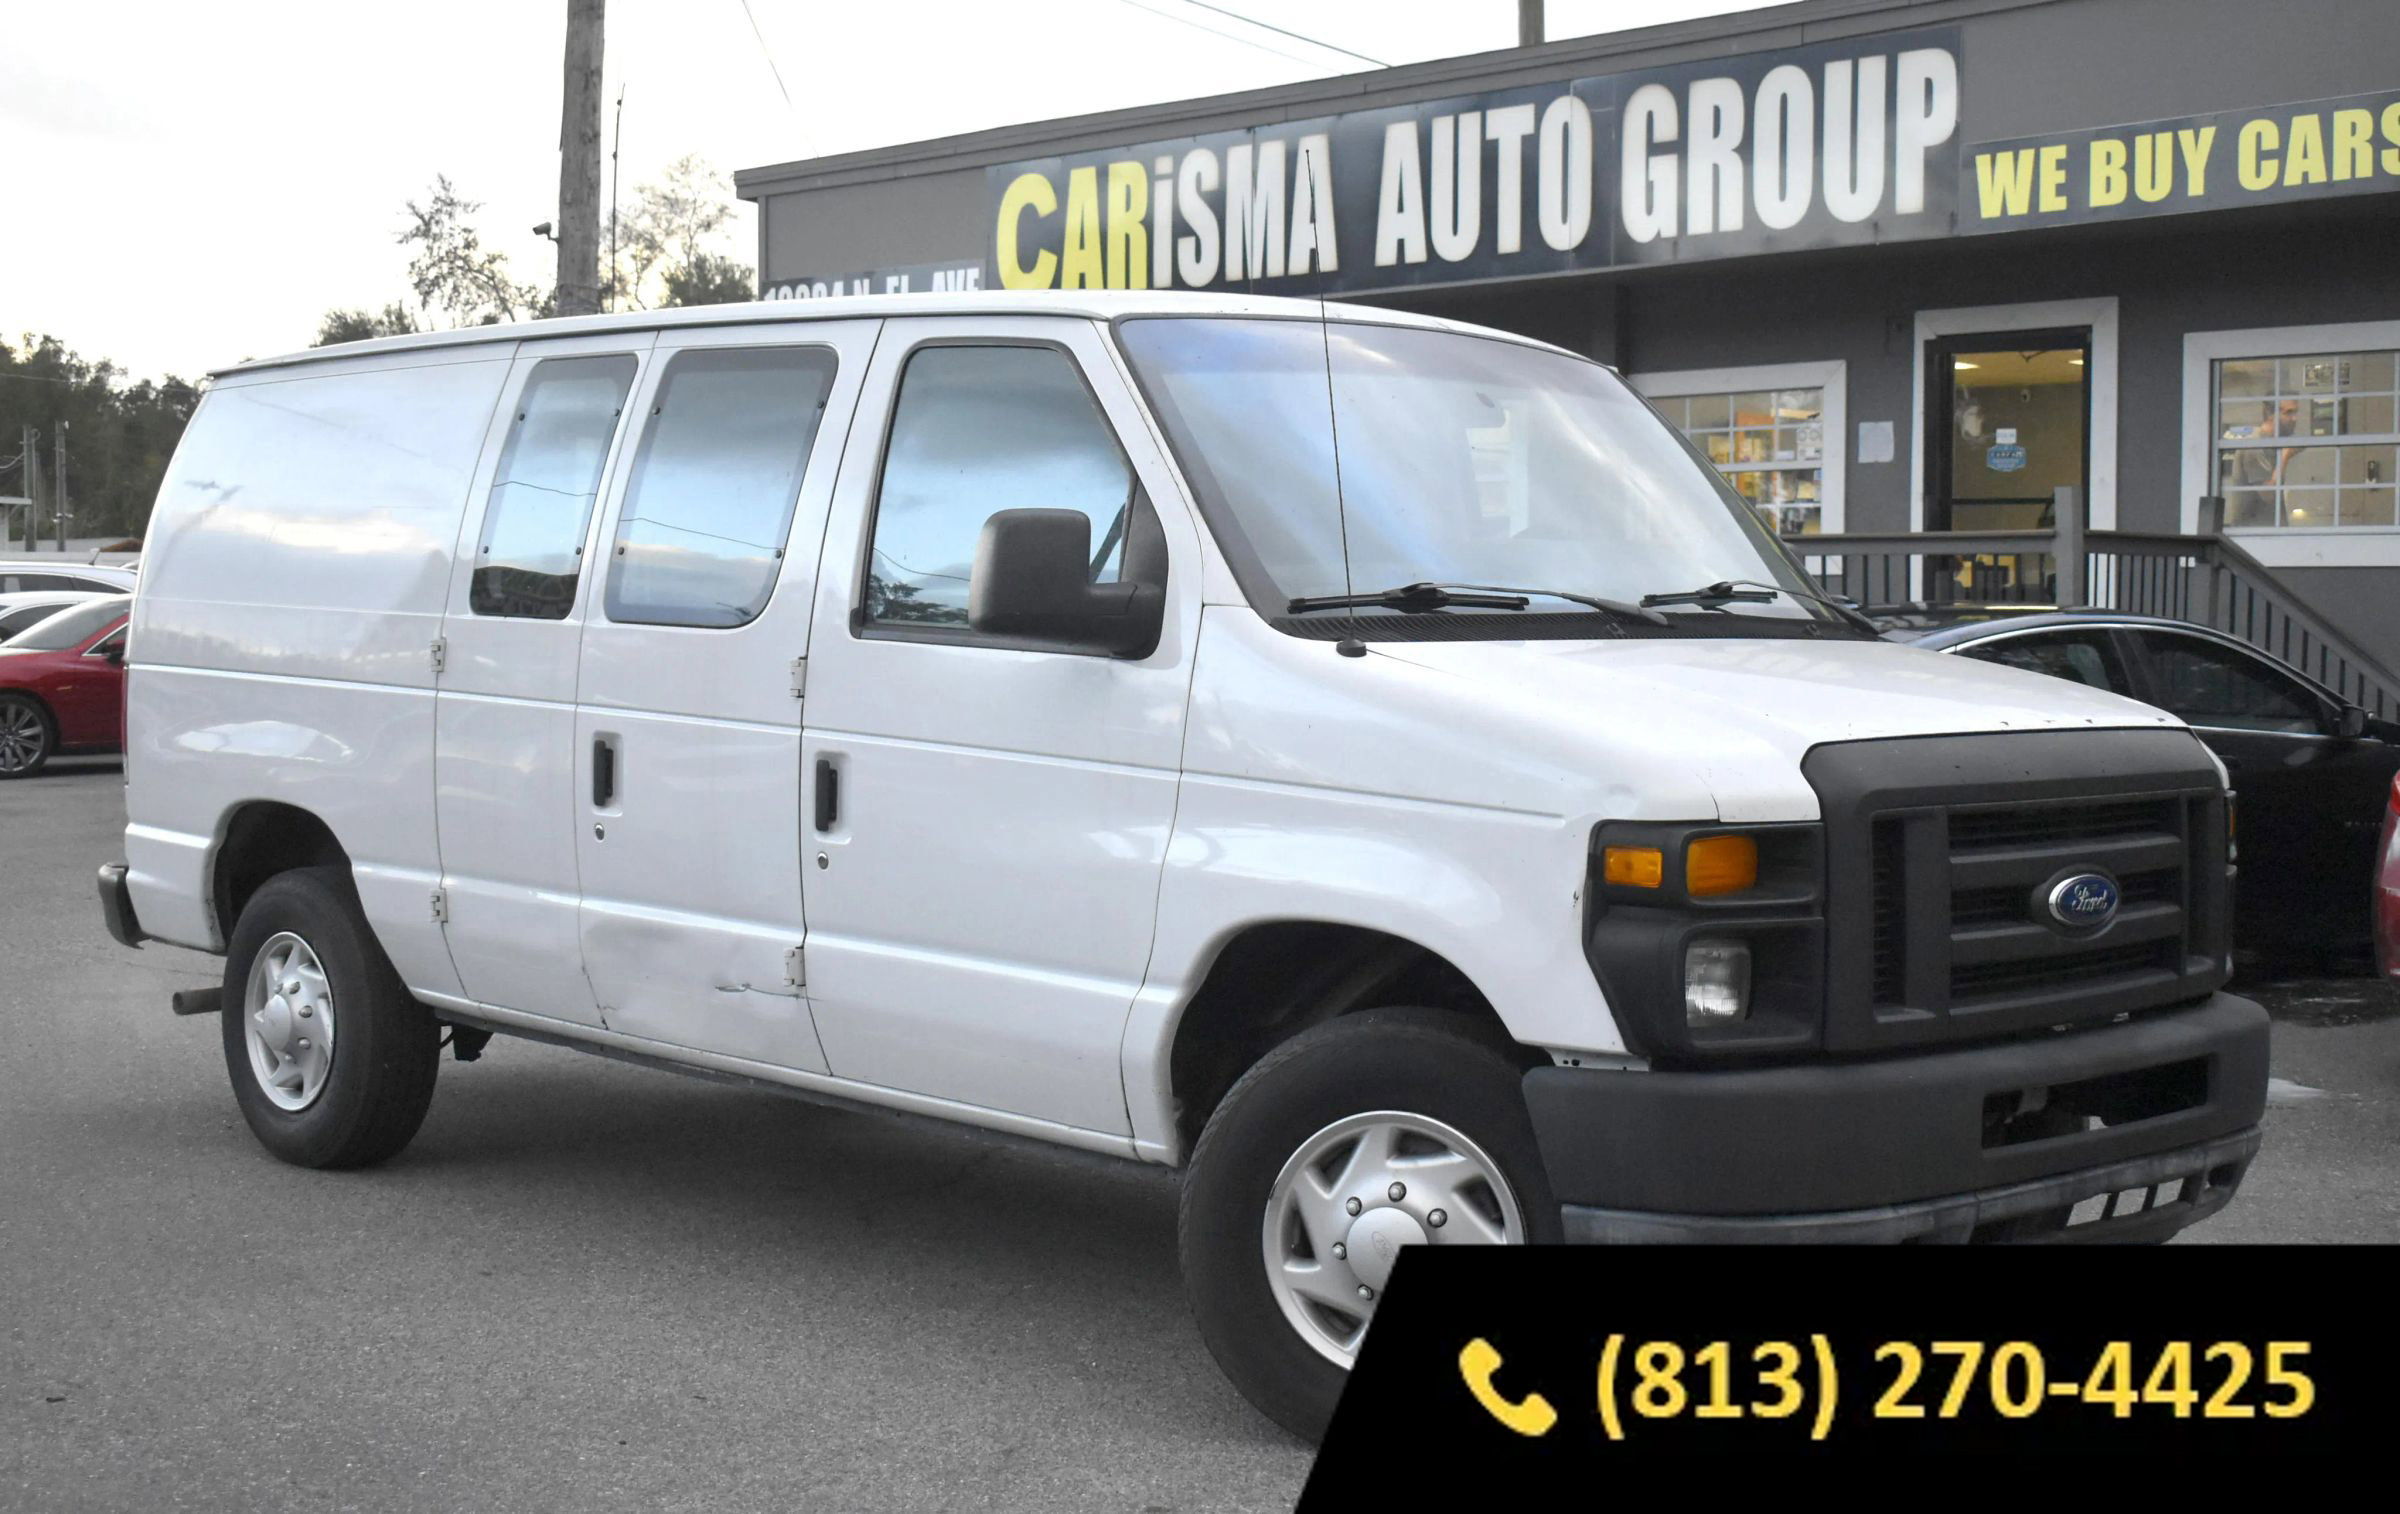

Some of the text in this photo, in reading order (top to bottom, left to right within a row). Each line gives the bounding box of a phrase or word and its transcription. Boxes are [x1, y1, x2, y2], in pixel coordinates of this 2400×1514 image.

[1375, 95, 1592, 266] AUTO
[1621, 48, 1958, 244] GROUP
[1975, 144, 2068, 219] WE
[2089, 126, 2216, 208] BUY
[2071, 884, 2108, 913] Ford
